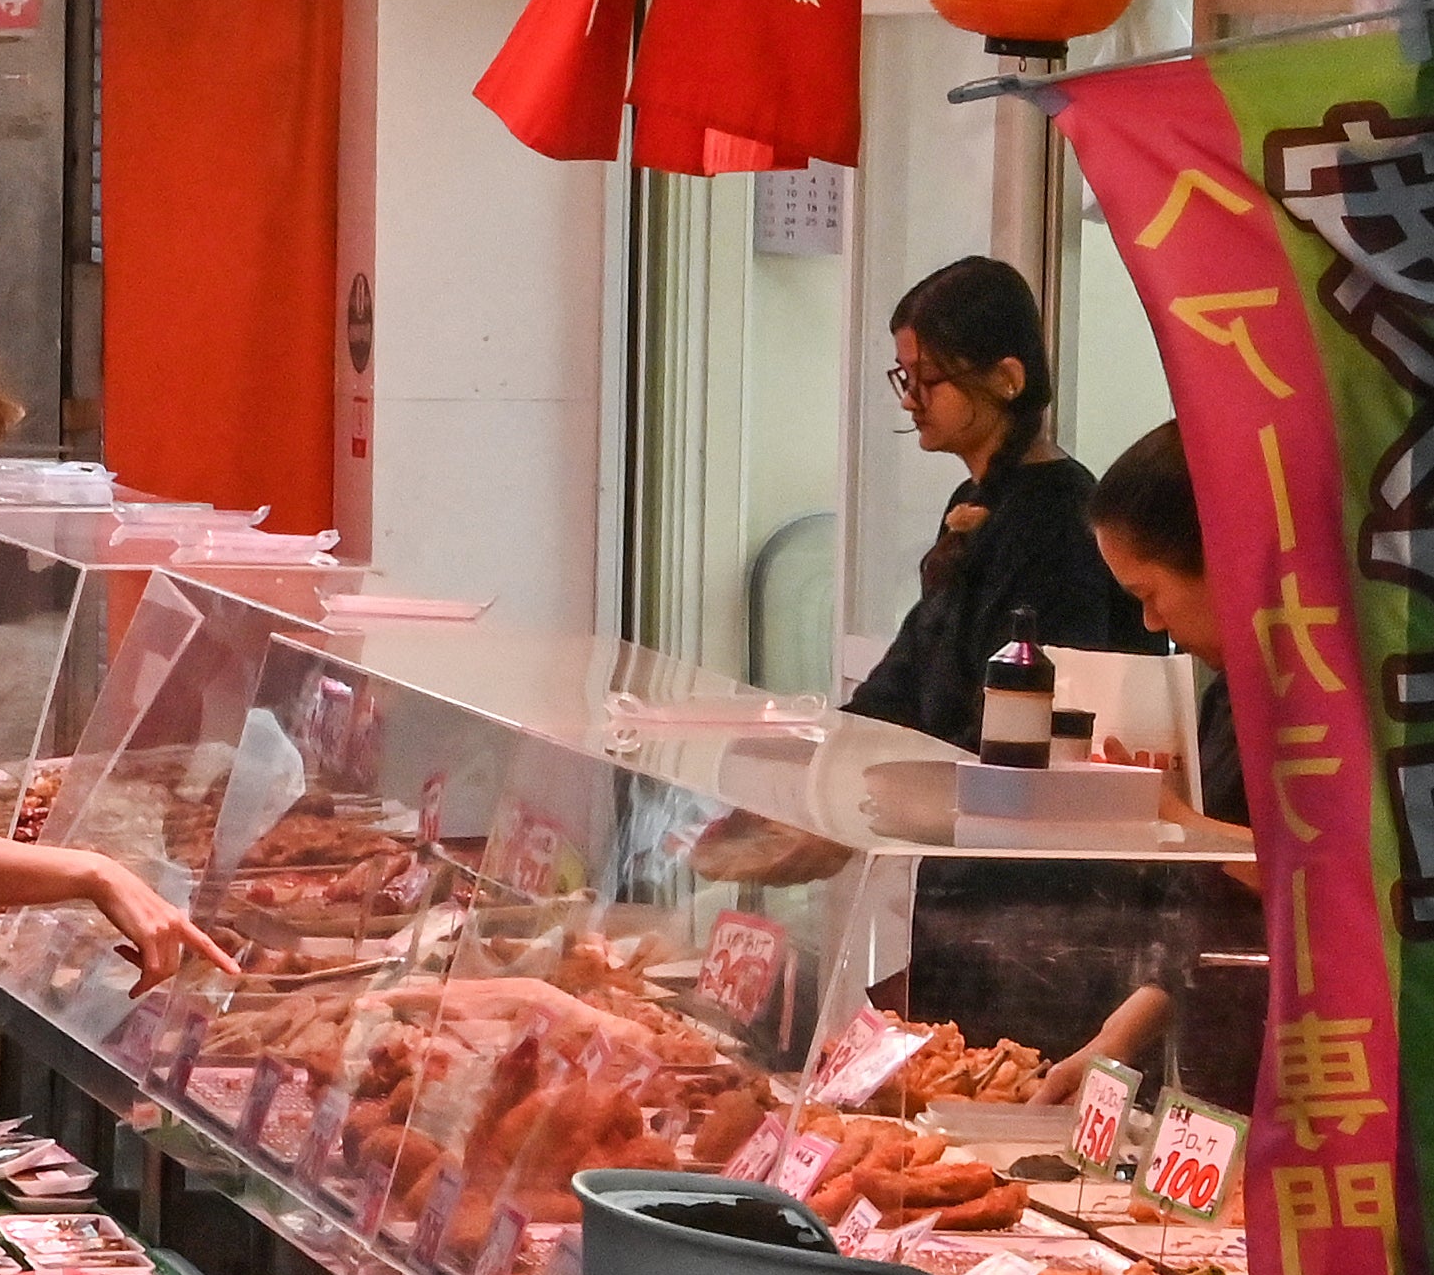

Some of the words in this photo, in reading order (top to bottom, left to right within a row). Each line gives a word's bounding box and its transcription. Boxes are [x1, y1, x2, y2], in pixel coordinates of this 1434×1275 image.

[1074, 1103, 1117, 1165] 150
[1170, 1127, 1219, 1157] コロッケ
[1153, 1150, 1220, 1209] 100
